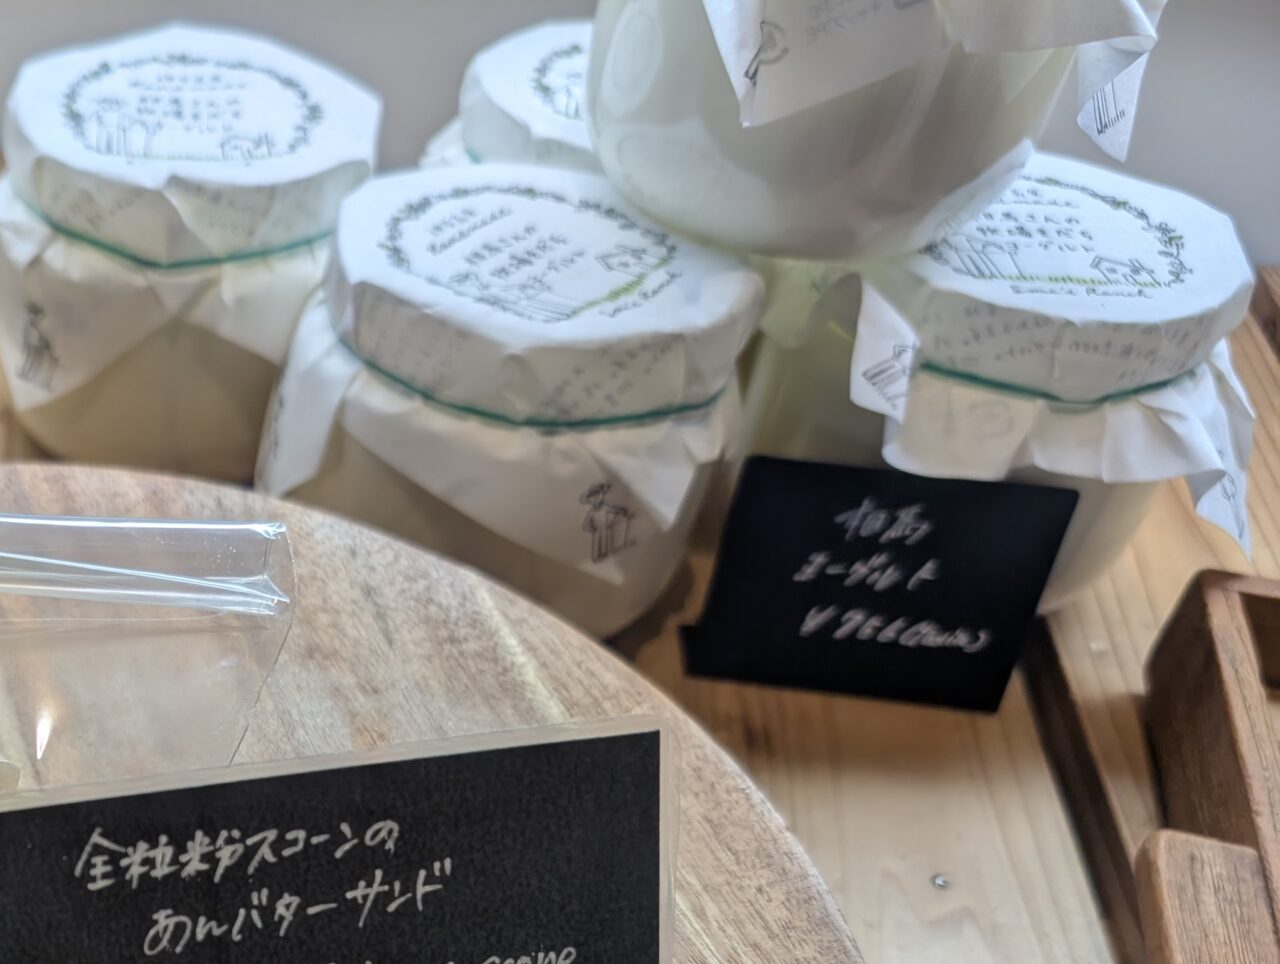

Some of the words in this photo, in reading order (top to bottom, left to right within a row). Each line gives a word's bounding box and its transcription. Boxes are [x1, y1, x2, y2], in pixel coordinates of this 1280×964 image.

[74, 818, 401, 891] 全粒粉スコーンの
[143, 857, 453, 956] あんバターサンド
